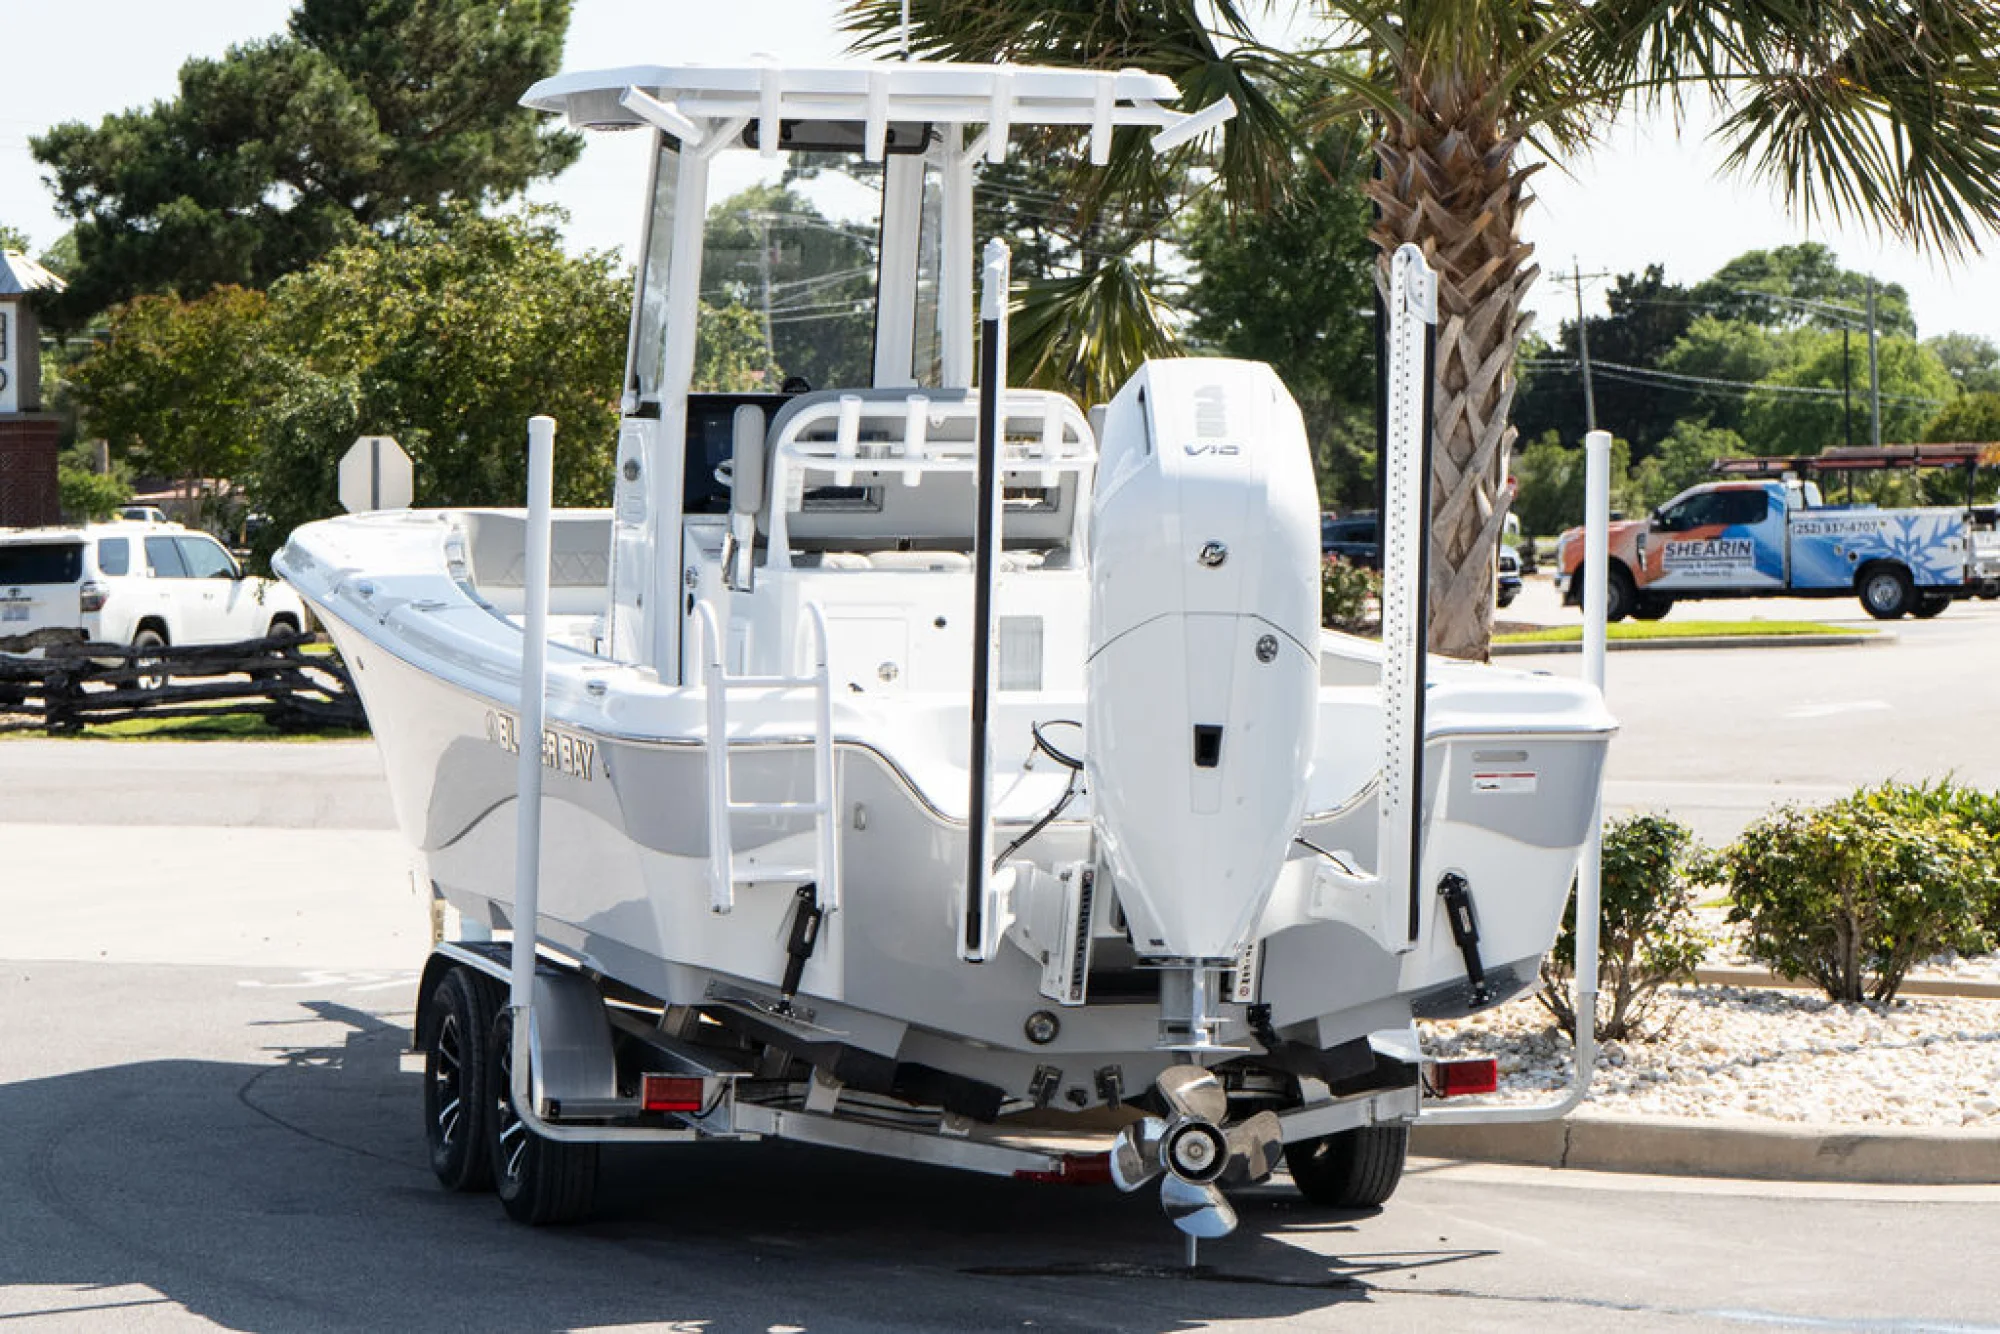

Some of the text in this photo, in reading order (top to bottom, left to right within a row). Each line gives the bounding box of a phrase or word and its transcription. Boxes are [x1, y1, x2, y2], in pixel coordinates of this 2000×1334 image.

[1665, 541, 1751, 556] SHEARIN
[498, 712, 594, 782] BLER BAY
